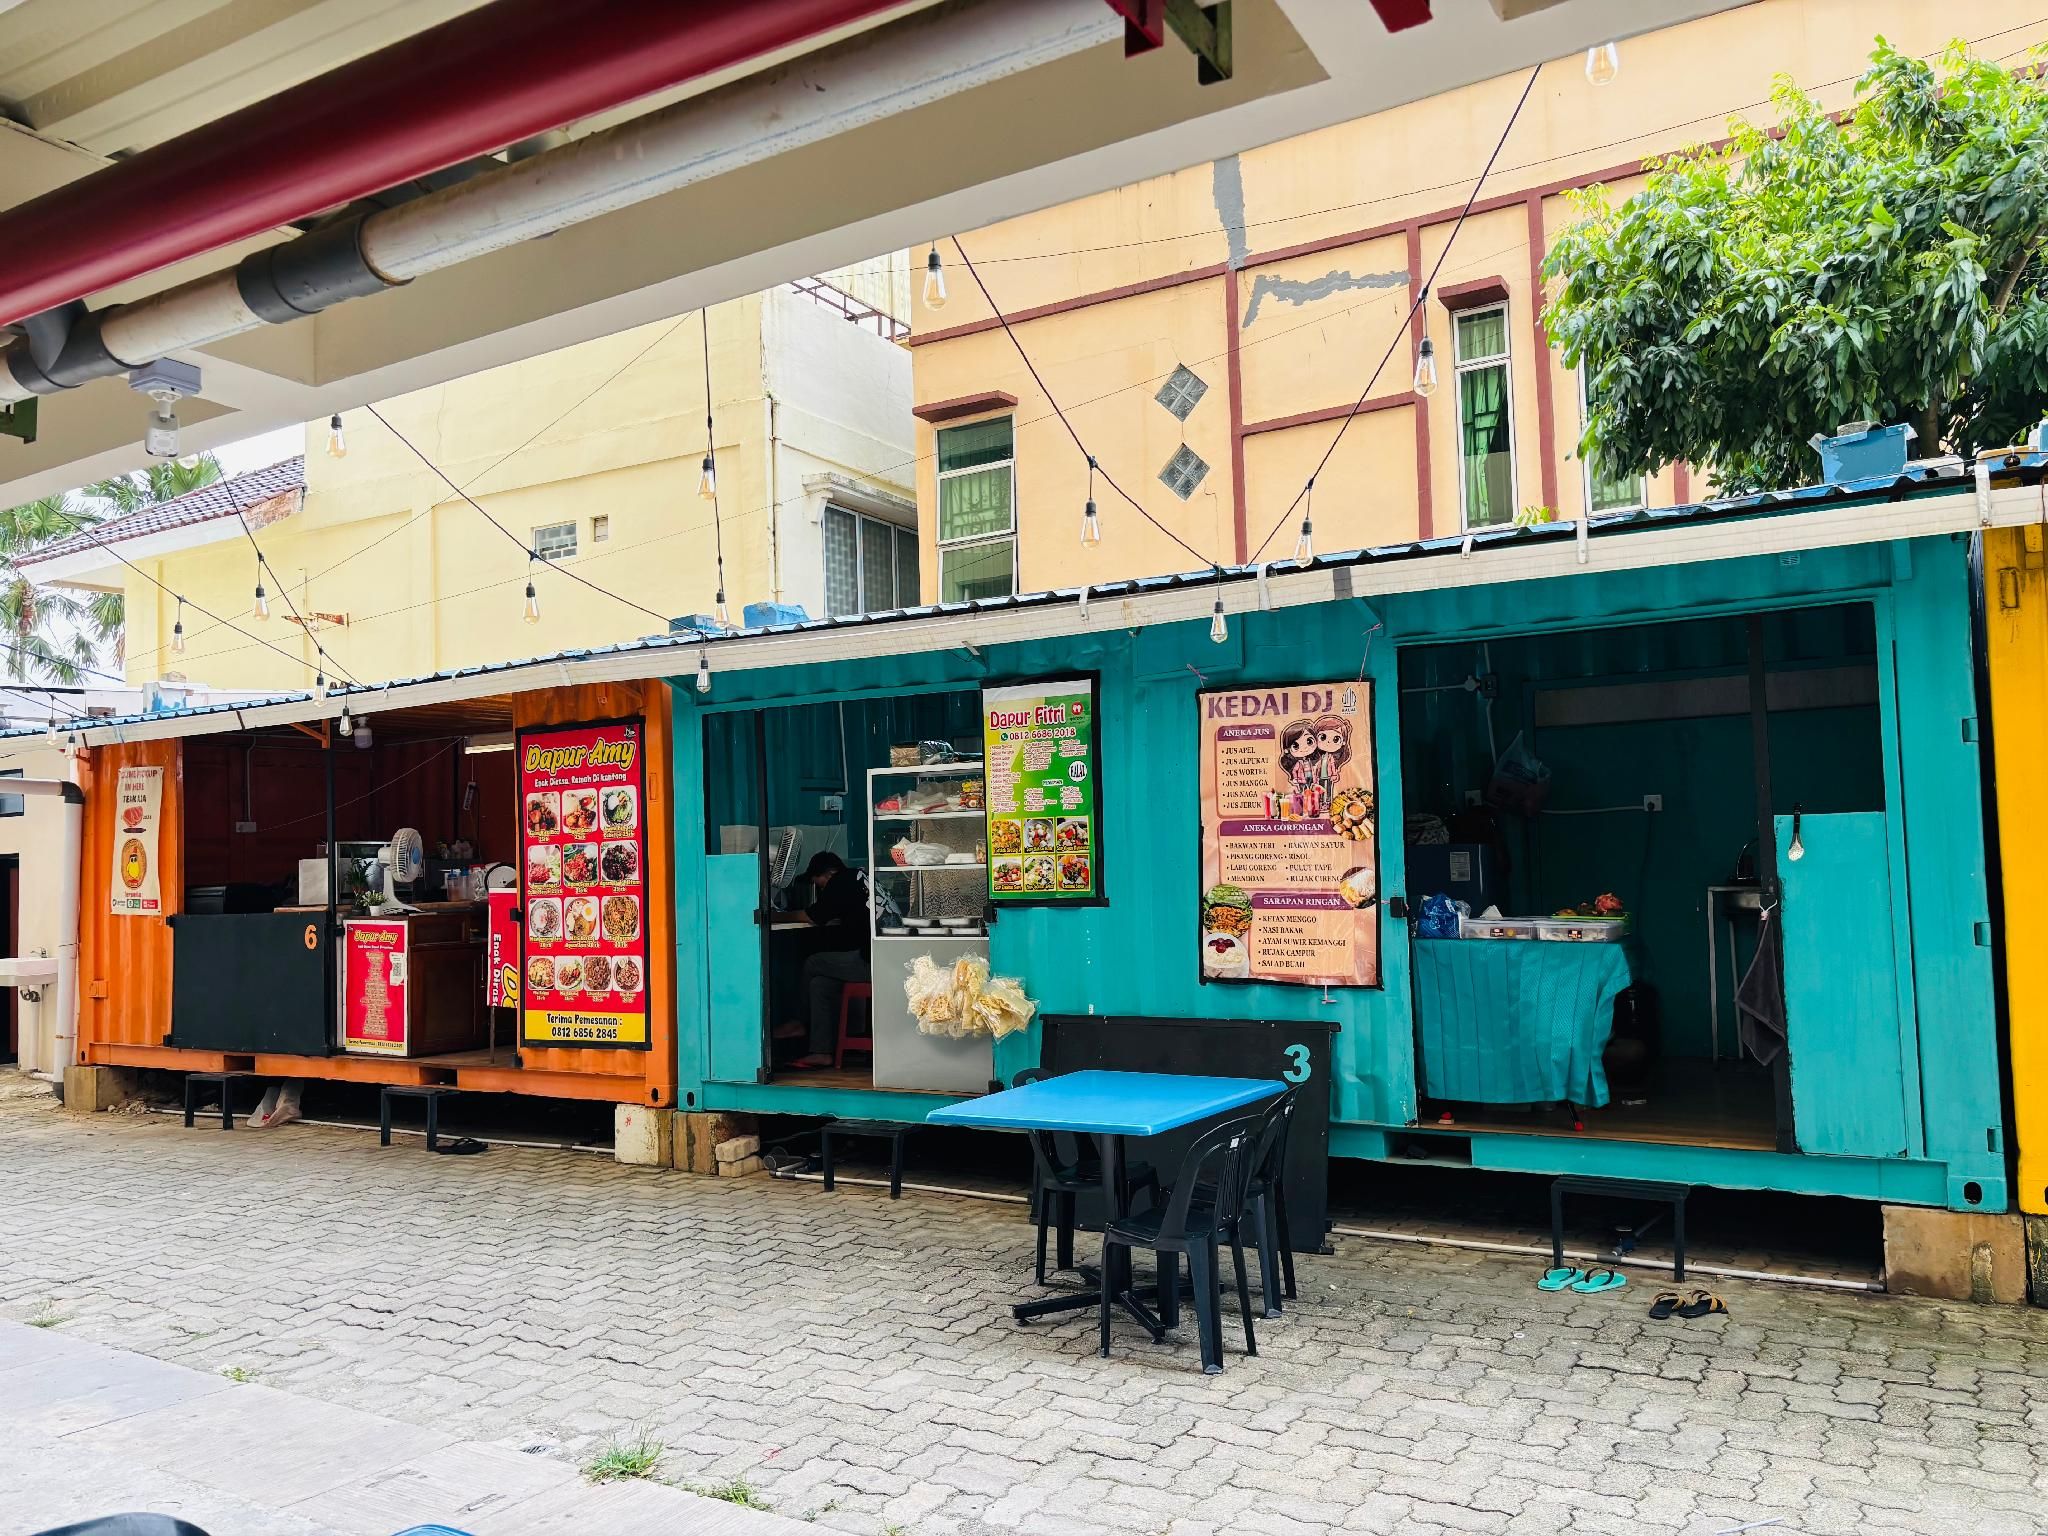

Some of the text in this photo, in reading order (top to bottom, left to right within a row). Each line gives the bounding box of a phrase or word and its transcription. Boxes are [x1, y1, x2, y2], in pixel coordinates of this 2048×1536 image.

[1208, 690, 1333, 718] KEDAI DJ
[990, 704, 1065, 730] Dapur Fitri
[1055, 728, 1076, 737] 2018
[1223, 729, 1252, 737] ANEKA
[526, 737, 636, 775] Dapur Amy
[1239, 757, 1269, 765] ALPUKAT
[1239, 768, 1268, 776] WORTEL
[1239, 779, 1269, 787] MANGGA
[1239, 790, 1258, 798] NAGA
[1240, 801, 1262, 809] JERUK
[1274, 823, 1324, 831] GORENGAN
[1305, 898, 1341, 906] RINGAN
[304, 924, 318, 950] 6
[493, 933, 502, 965] Enak
[547, 1014, 572, 1024] Terima
[575, 1015, 618, 1025] Pemesanan
[552, 1027, 617, 1039] 0812 6856 2845
[1283, 1044, 1311, 1083] 3
